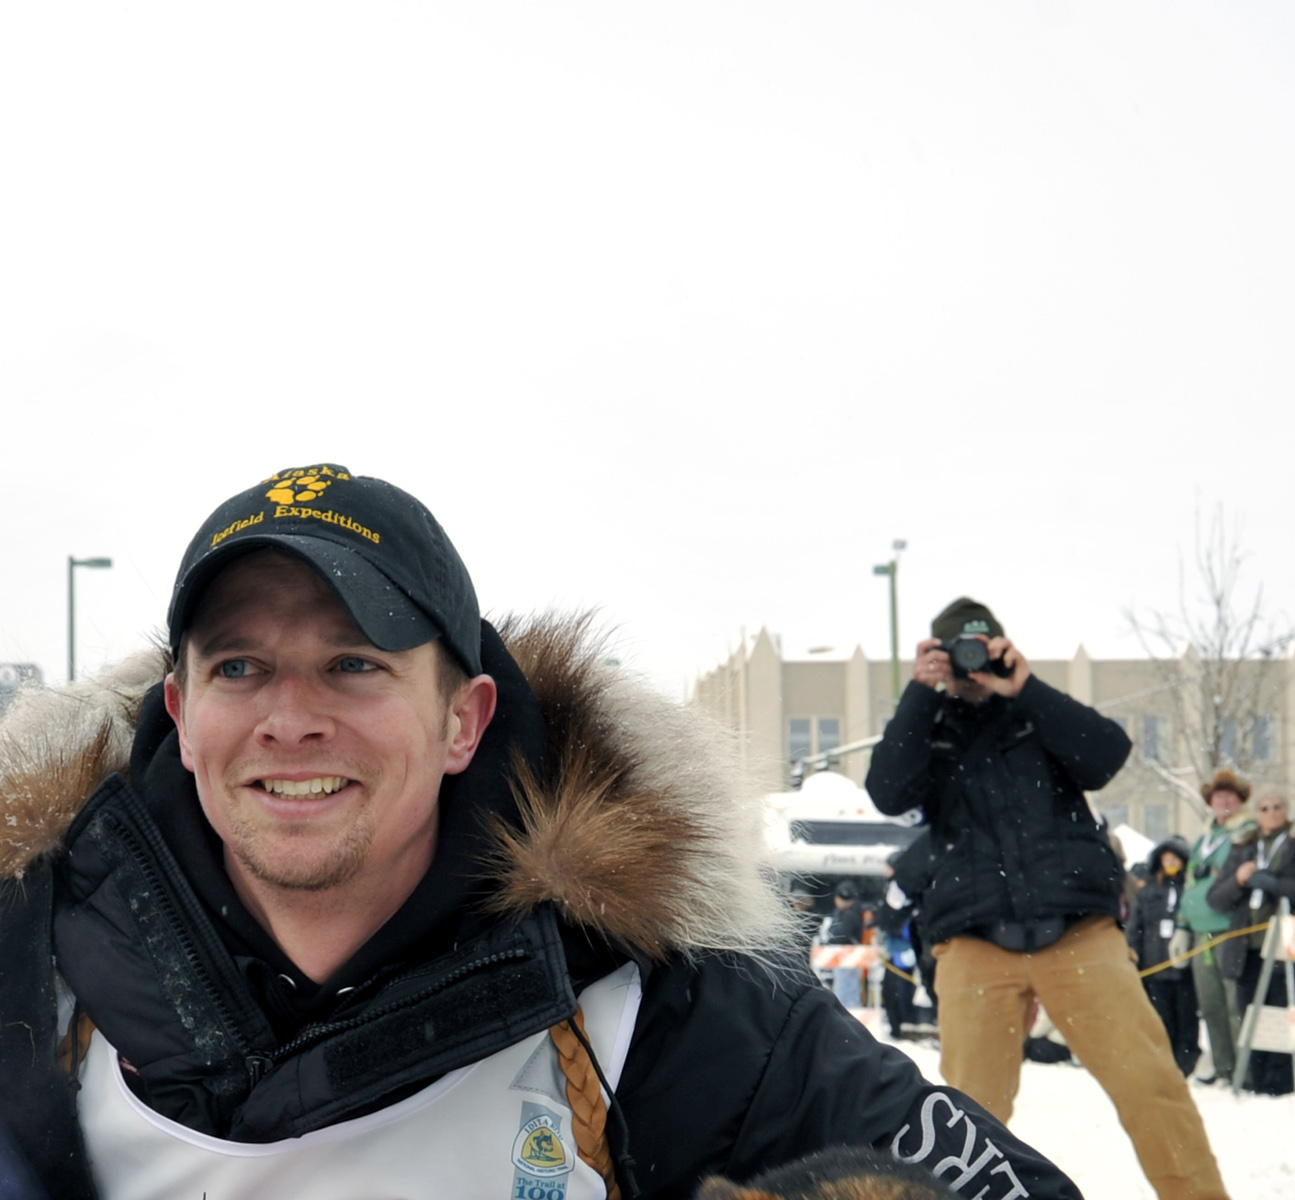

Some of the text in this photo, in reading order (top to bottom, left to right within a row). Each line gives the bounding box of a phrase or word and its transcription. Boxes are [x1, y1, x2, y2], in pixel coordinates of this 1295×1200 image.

[262, 466, 350, 482] Alaska
[211, 505, 381, 547] Icefield Expeditions
[517, 1177, 565, 1189] The Trail at
